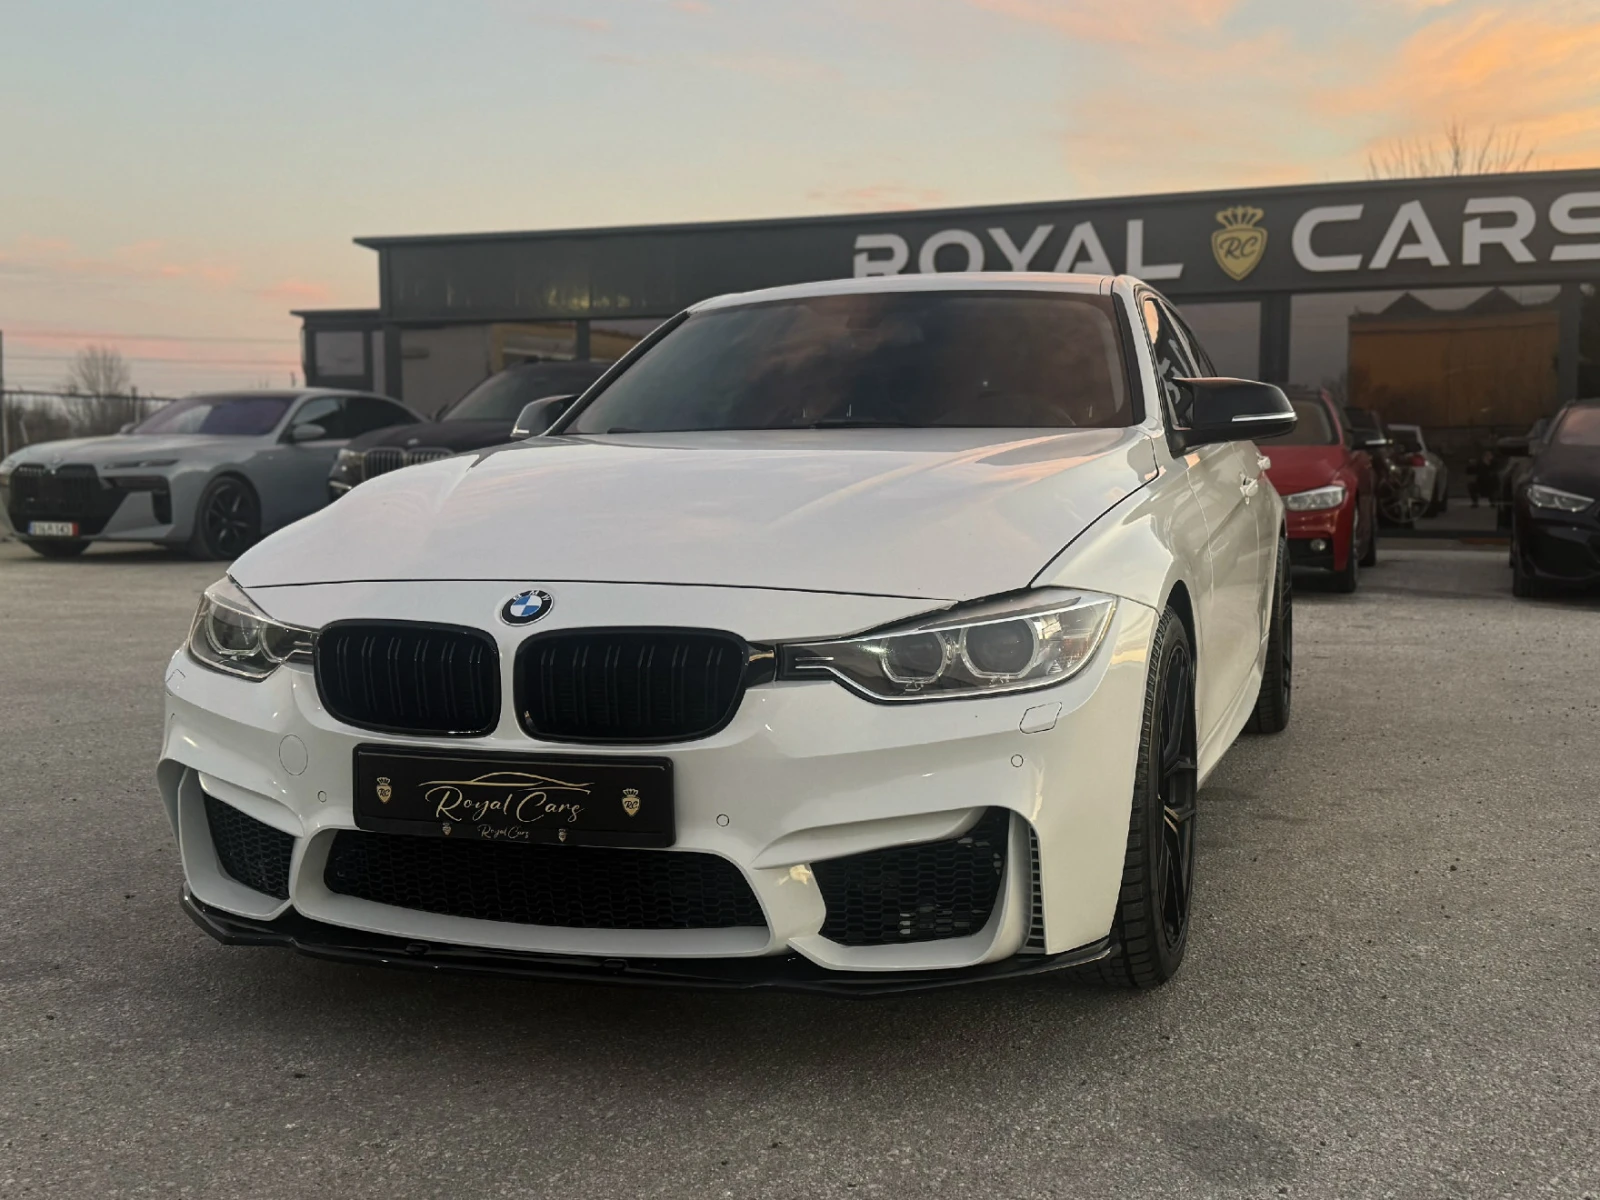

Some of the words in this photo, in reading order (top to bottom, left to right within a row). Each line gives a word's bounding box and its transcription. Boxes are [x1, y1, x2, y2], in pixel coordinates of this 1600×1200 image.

[853, 219, 1184, 279] ROYAL
[1291, 191, 1600, 272] CARS
[1219, 235, 1259, 260] RC
[513, 590, 551, 601] BMW
[425, 786, 513, 821] Royal
[516, 790, 585, 822] Cars
[478, 824, 507, 838] Royal
